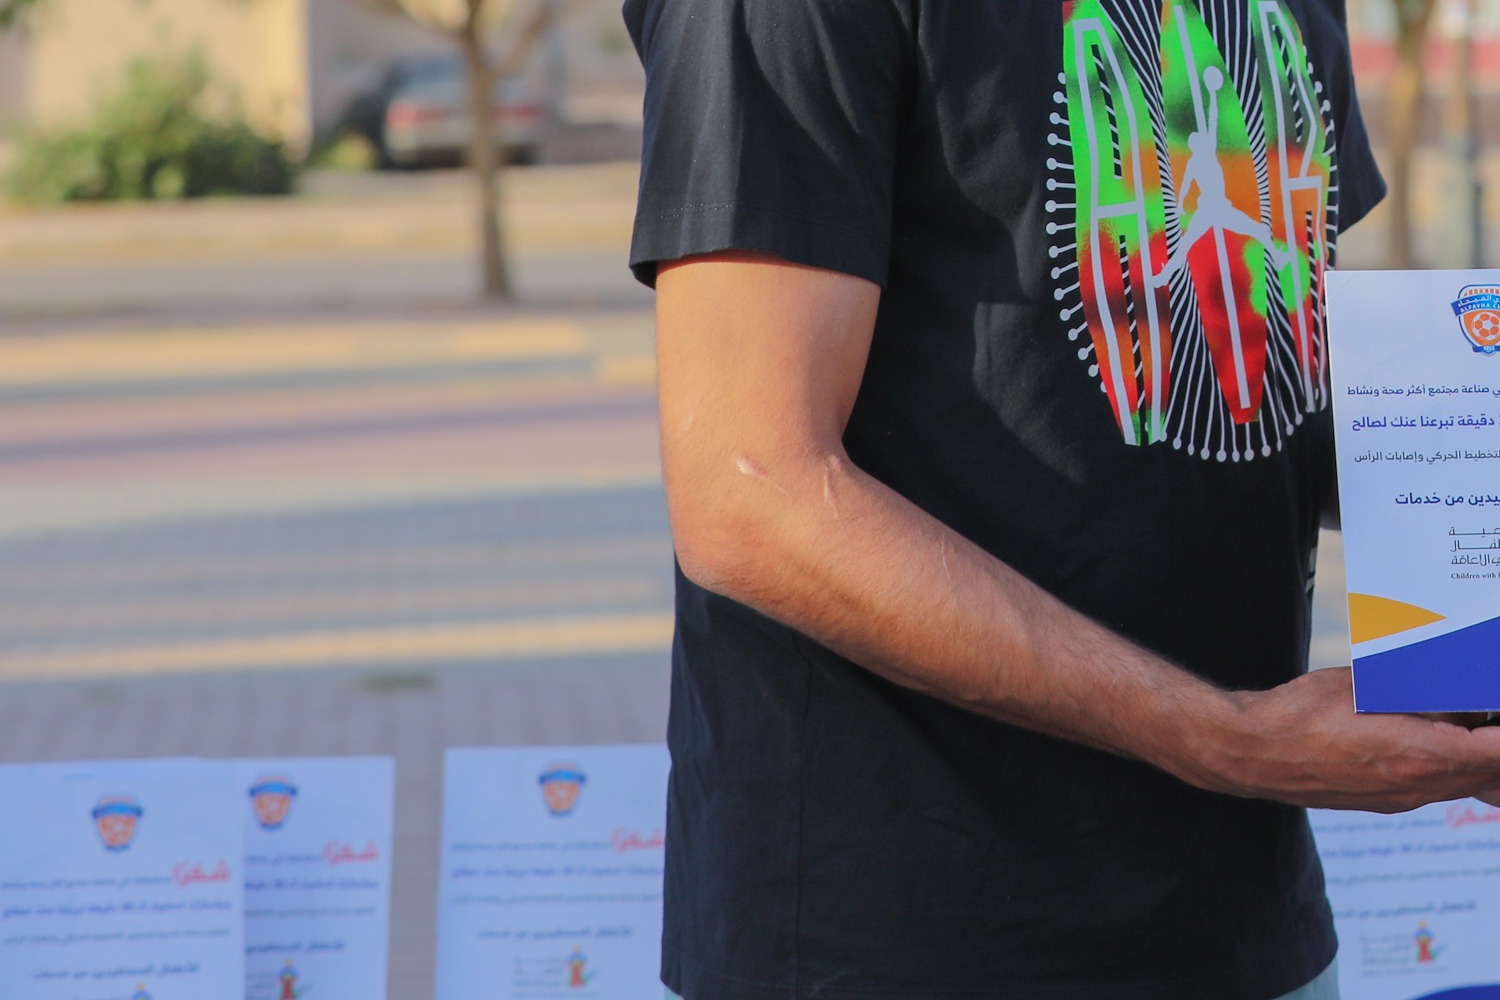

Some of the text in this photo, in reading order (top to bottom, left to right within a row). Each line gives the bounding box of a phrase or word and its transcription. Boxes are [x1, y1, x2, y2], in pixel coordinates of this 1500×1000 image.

[1460, 303, 1490, 313] ALFAYHA
[1347, 385, 1380, 397] ونشاط
[1381, 386, 1404, 395] صحة
[1406, 384, 1426, 396] أكثر
[1428, 385, 1459, 396] مجتمع
[1461, 384, 1490, 394] صناعة
[1352, 416, 1387, 431] لصالح
[1390, 415, 1417, 427] عنك
[1420, 415, 1454, 429] تبرعنا
[1457, 413, 1495, 429] دقيقة
[1354, 450, 1382, 463] الرأس
[1385, 450, 1424, 463] وإصابات
[1426, 450, 1461, 465] الحركي
[1395, 492, 1441, 505] خدمات
[1445, 494, 1464, 506] من
